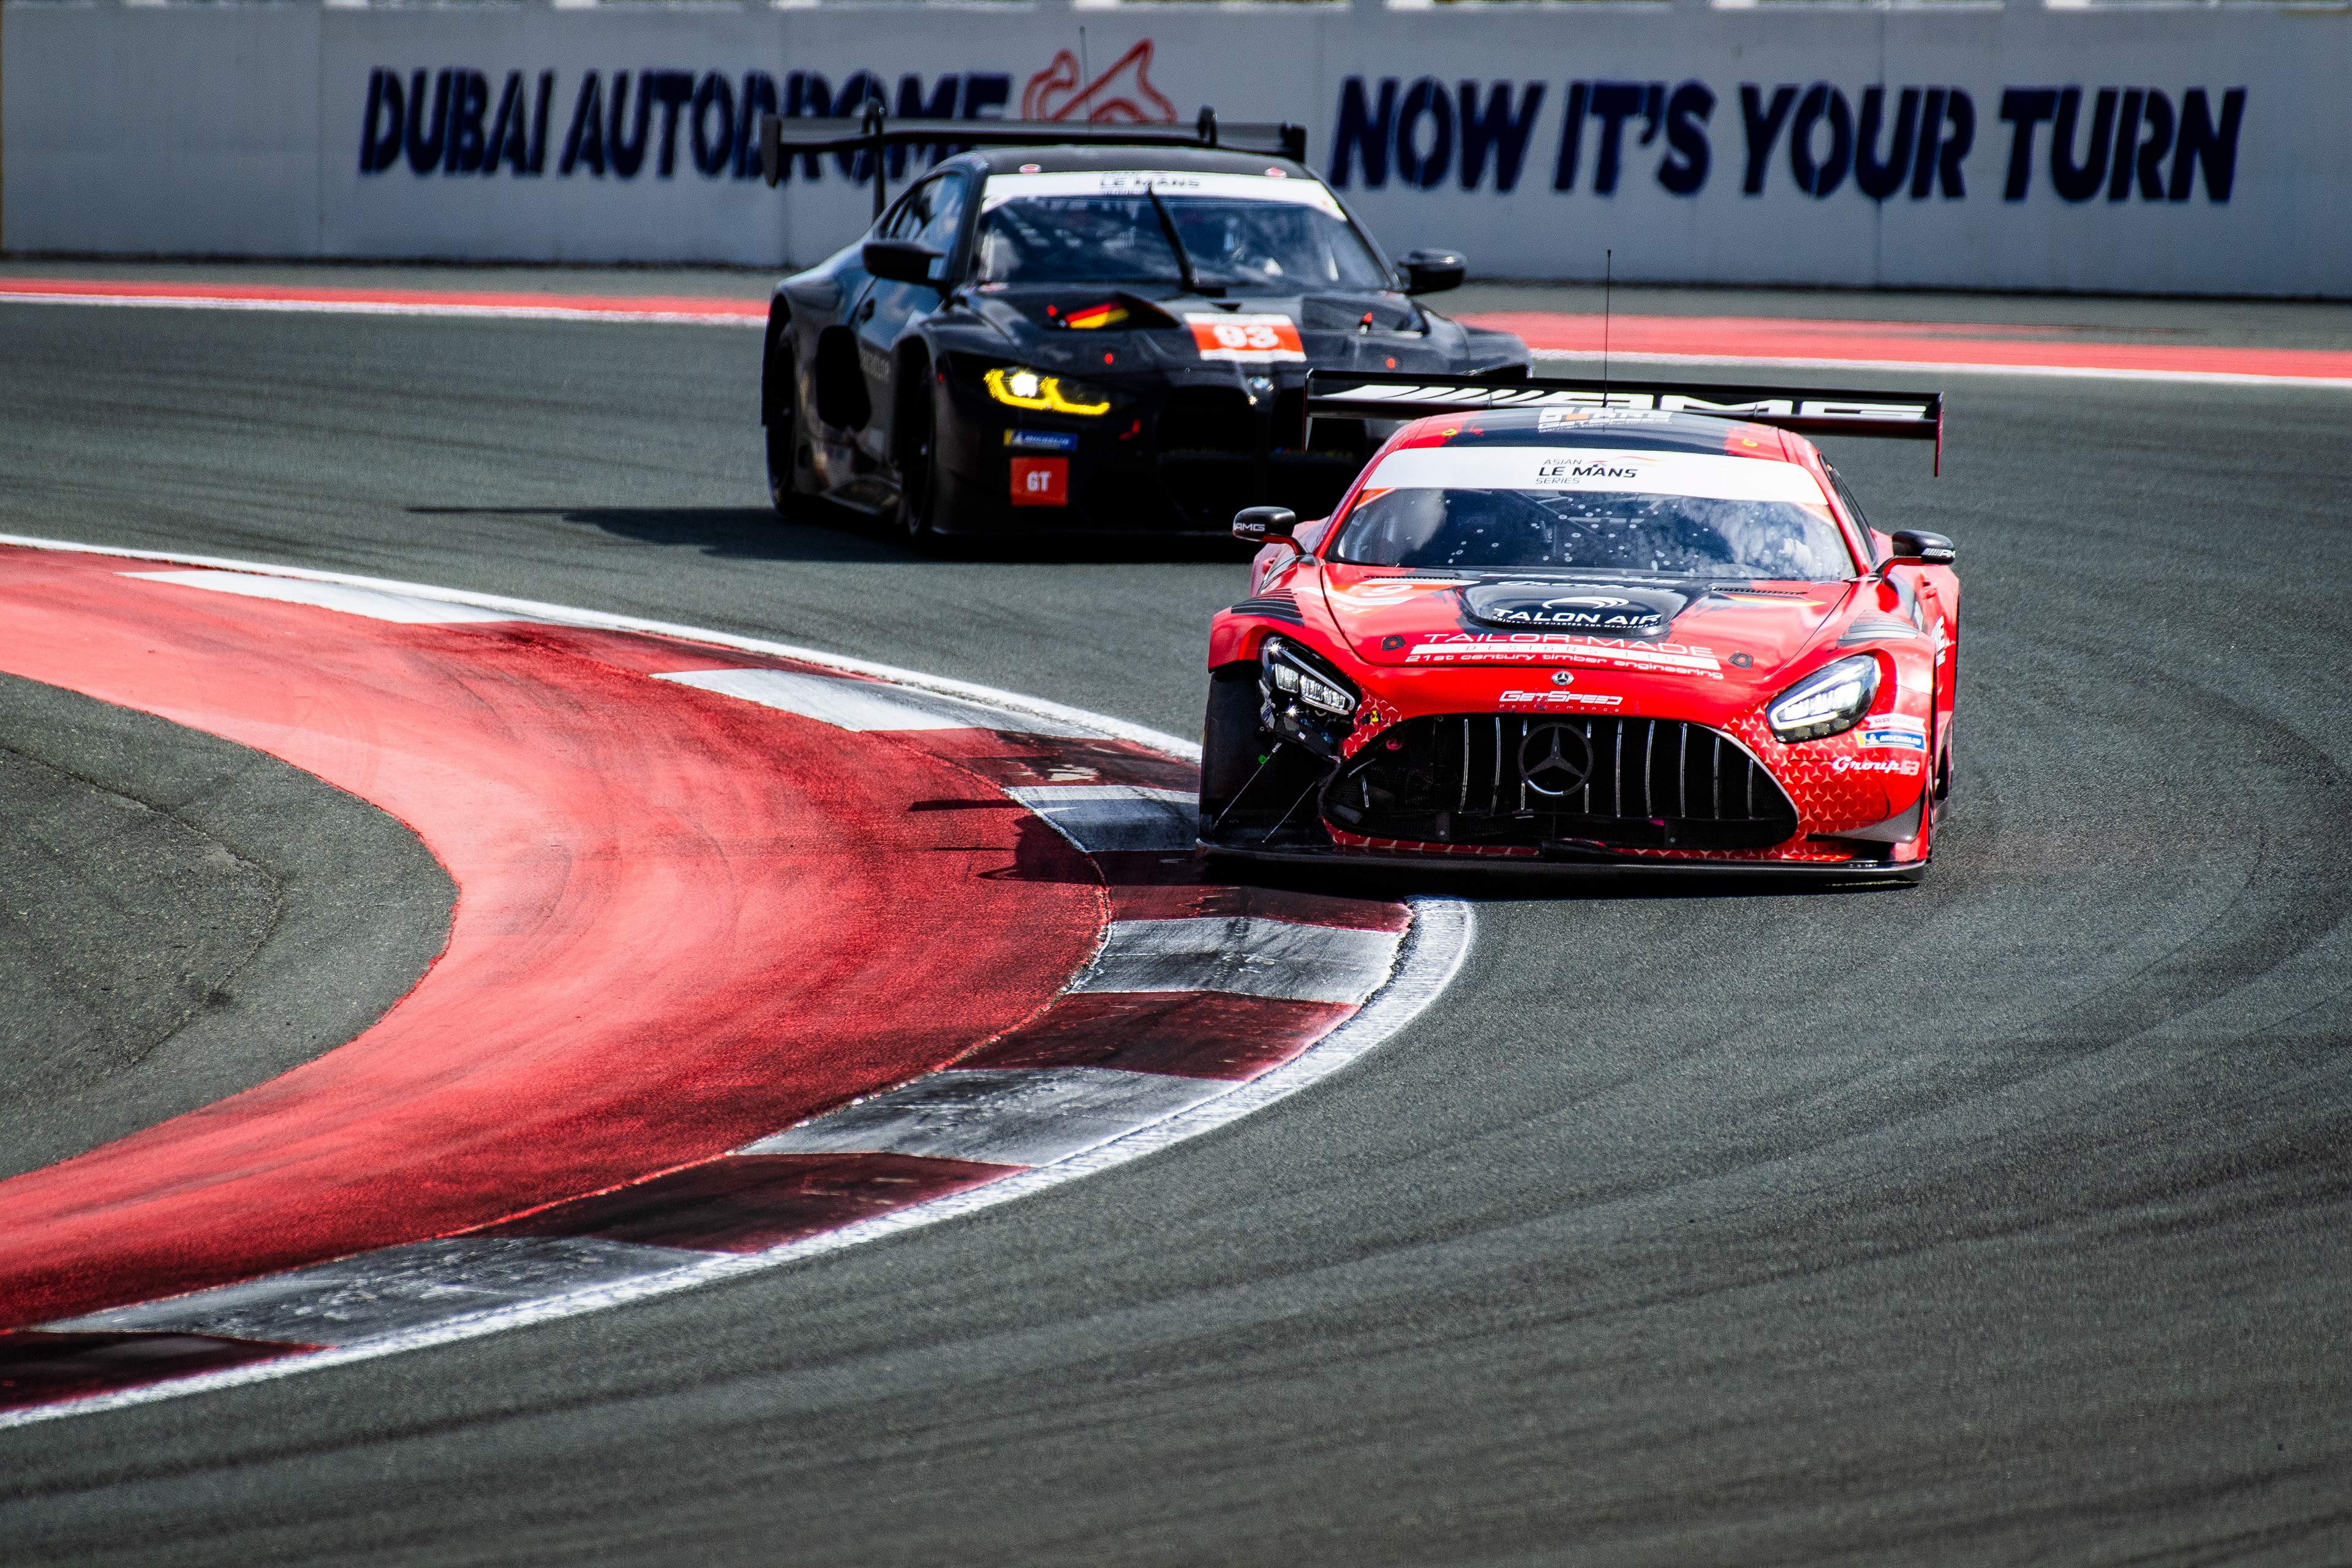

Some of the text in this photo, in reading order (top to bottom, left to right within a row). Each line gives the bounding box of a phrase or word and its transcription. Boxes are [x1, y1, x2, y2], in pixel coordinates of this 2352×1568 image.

[360, 67, 554, 176] DUBAI
[1328, 75, 2248, 203] NOW IT'S YOUR TURN
[1213, 325, 1279, 348] 93
[1539, 467, 1638, 478] LE MANS
[1027, 471, 1052, 492] GT
[1235, 522, 1265, 532] AMG
[1362, 584, 1413, 597] 9
[1333, 603, 1373, 613] GT
[1493, 608, 1662, 625] TALON AIR
[1424, 633, 1716, 658] TAILOR-MADE
[1466, 644, 1598, 655] DESIGNS
[1542, 653, 1607, 664] timber
[1613, 660, 1725, 680] engineering
[1879, 734, 1922, 745] MICHELIN
